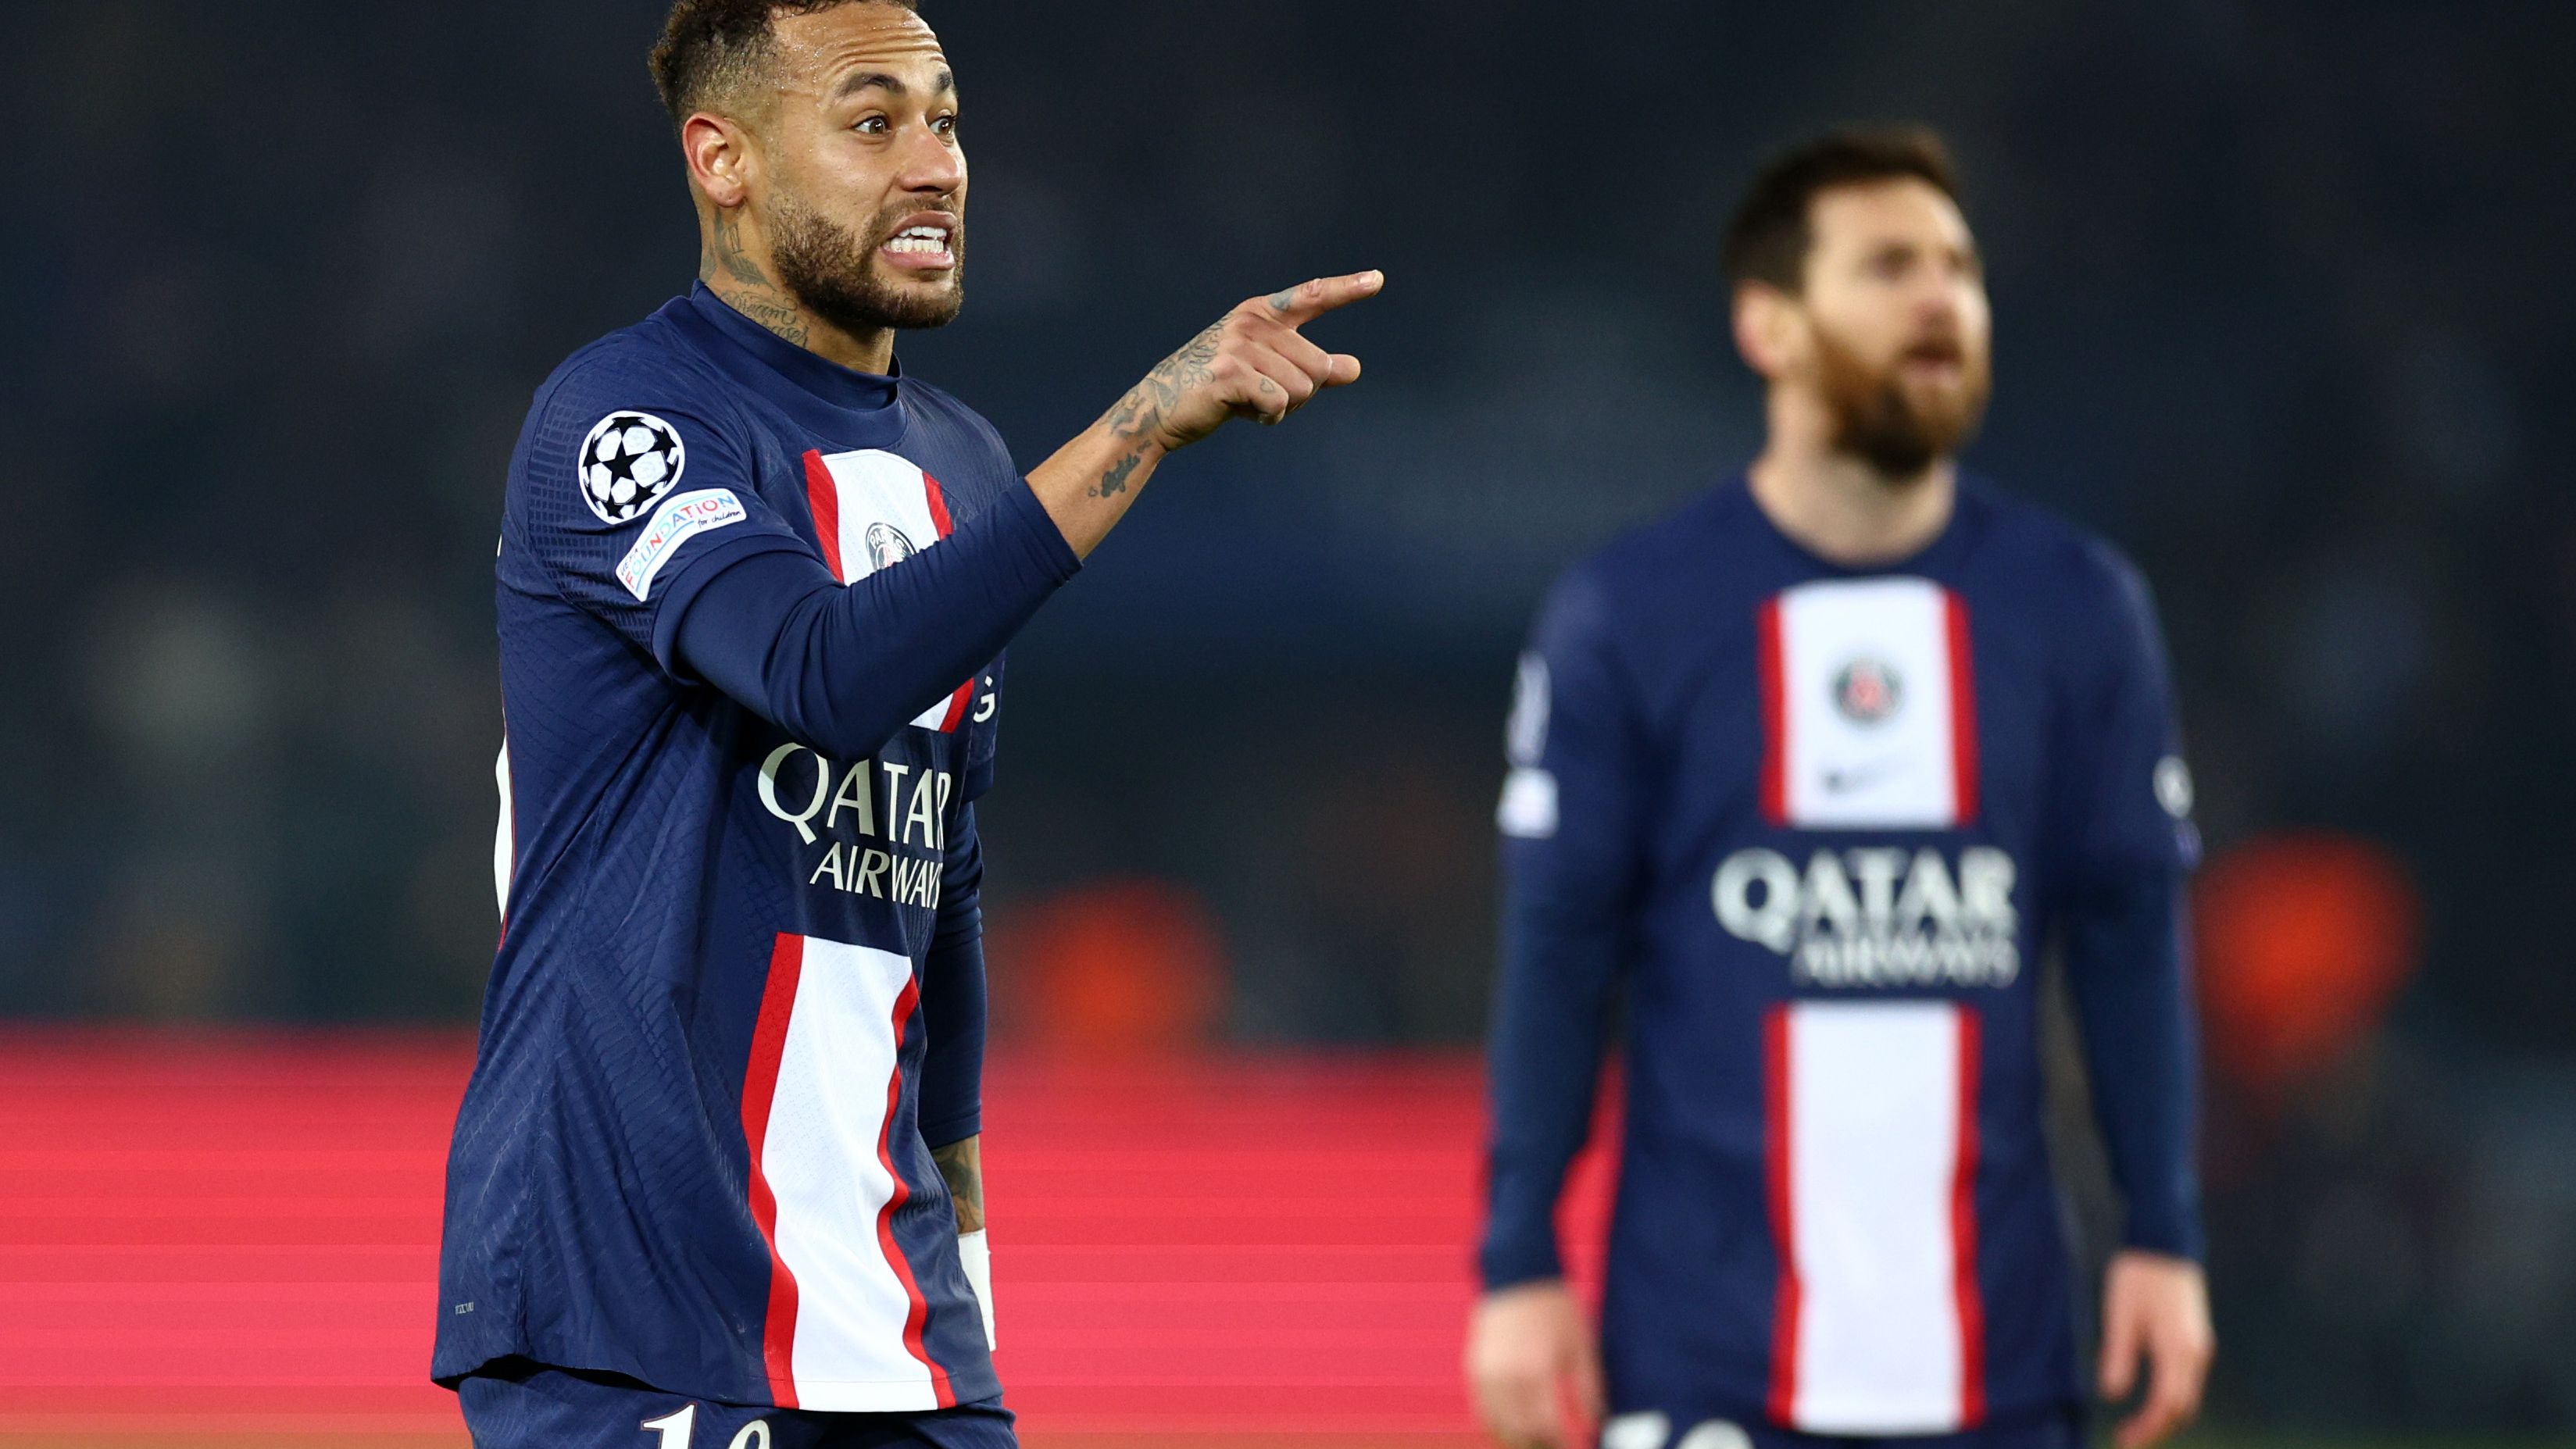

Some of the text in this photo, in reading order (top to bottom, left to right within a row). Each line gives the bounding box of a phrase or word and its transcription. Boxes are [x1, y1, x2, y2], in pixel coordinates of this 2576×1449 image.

[625, 495, 735, 588] FOUNDATION
[711, 510, 741, 524] children
[758, 742, 951, 851] QATAR
[809, 841, 944, 910] AIRWAYS
[1711, 847, 2019, 956] QATAR
